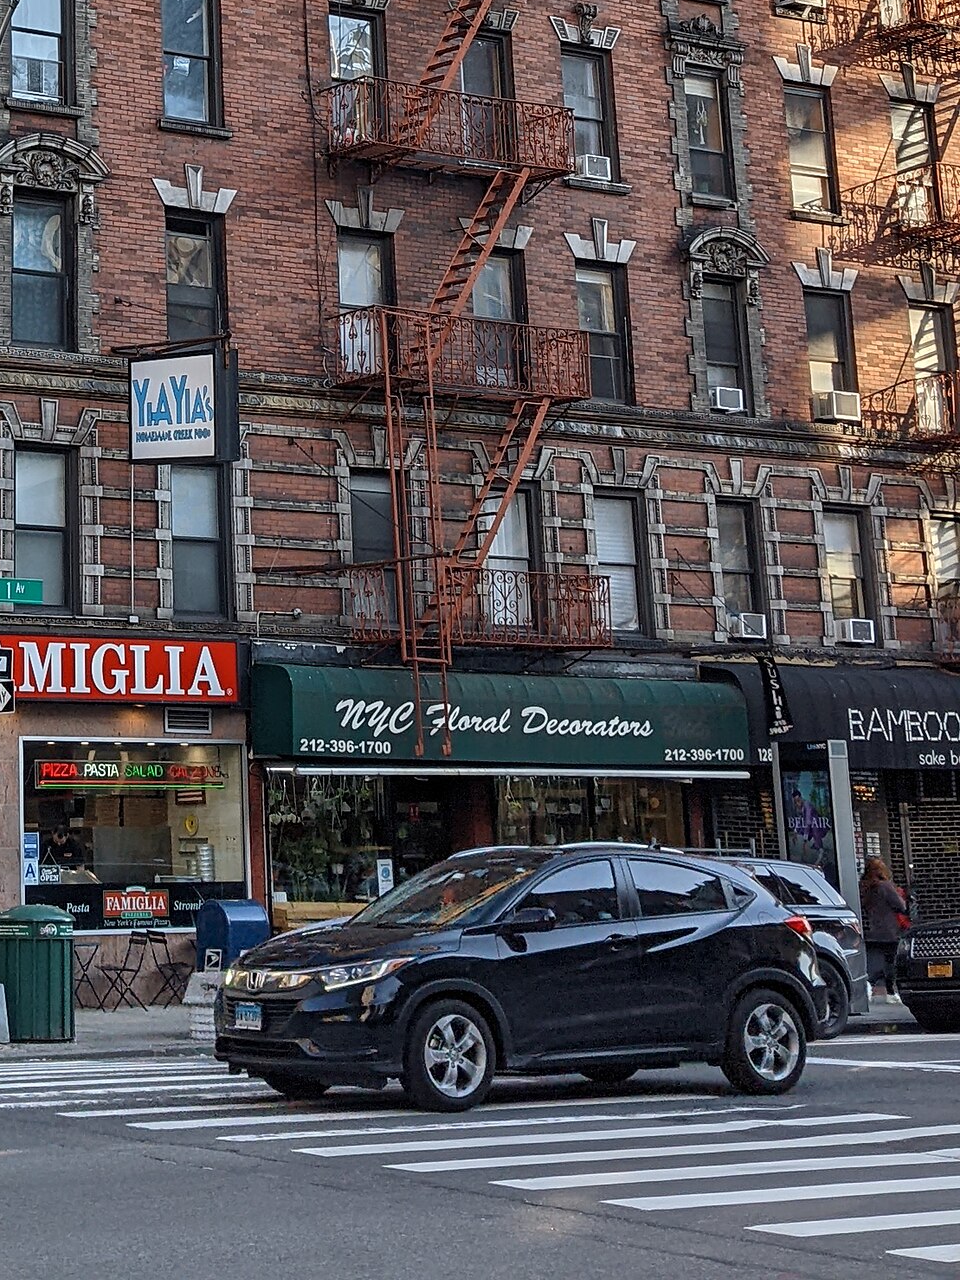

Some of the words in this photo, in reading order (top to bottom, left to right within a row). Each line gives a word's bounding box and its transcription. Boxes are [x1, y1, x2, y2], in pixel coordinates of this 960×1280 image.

[135, 429, 172, 443] HOMEMADE
[173, 428, 193, 440] GREEK
[194, 427, 211, 439] FOOD
[6, 581, 11, 599] 1
[15, 582, 25, 594] Av
[336, 698, 415, 738] NYC
[426, 703, 511, 736] Floral
[520, 706, 654, 738] Decorators
[300, 738, 391, 754] 212-396-1700
[664, 748, 745, 761] 212-396-1700
[919, 749, 946, 766] sake
[42, 763, 78, 777] PIZZA
[84, 763, 119, 778] PASTA
[124, 763, 164, 778] SALAD
[788, 817, 806, 829] BEL
[811, 816, 832, 828] AIR
[25, 863, 36, 878] A
[40, 874, 59, 882] OPEN
[66, 902, 90, 913] Pasta
[105, 896, 166, 911] FAMIGLIA
[104, 919, 116, 927] New
[117, 919, 133, 927] York's
